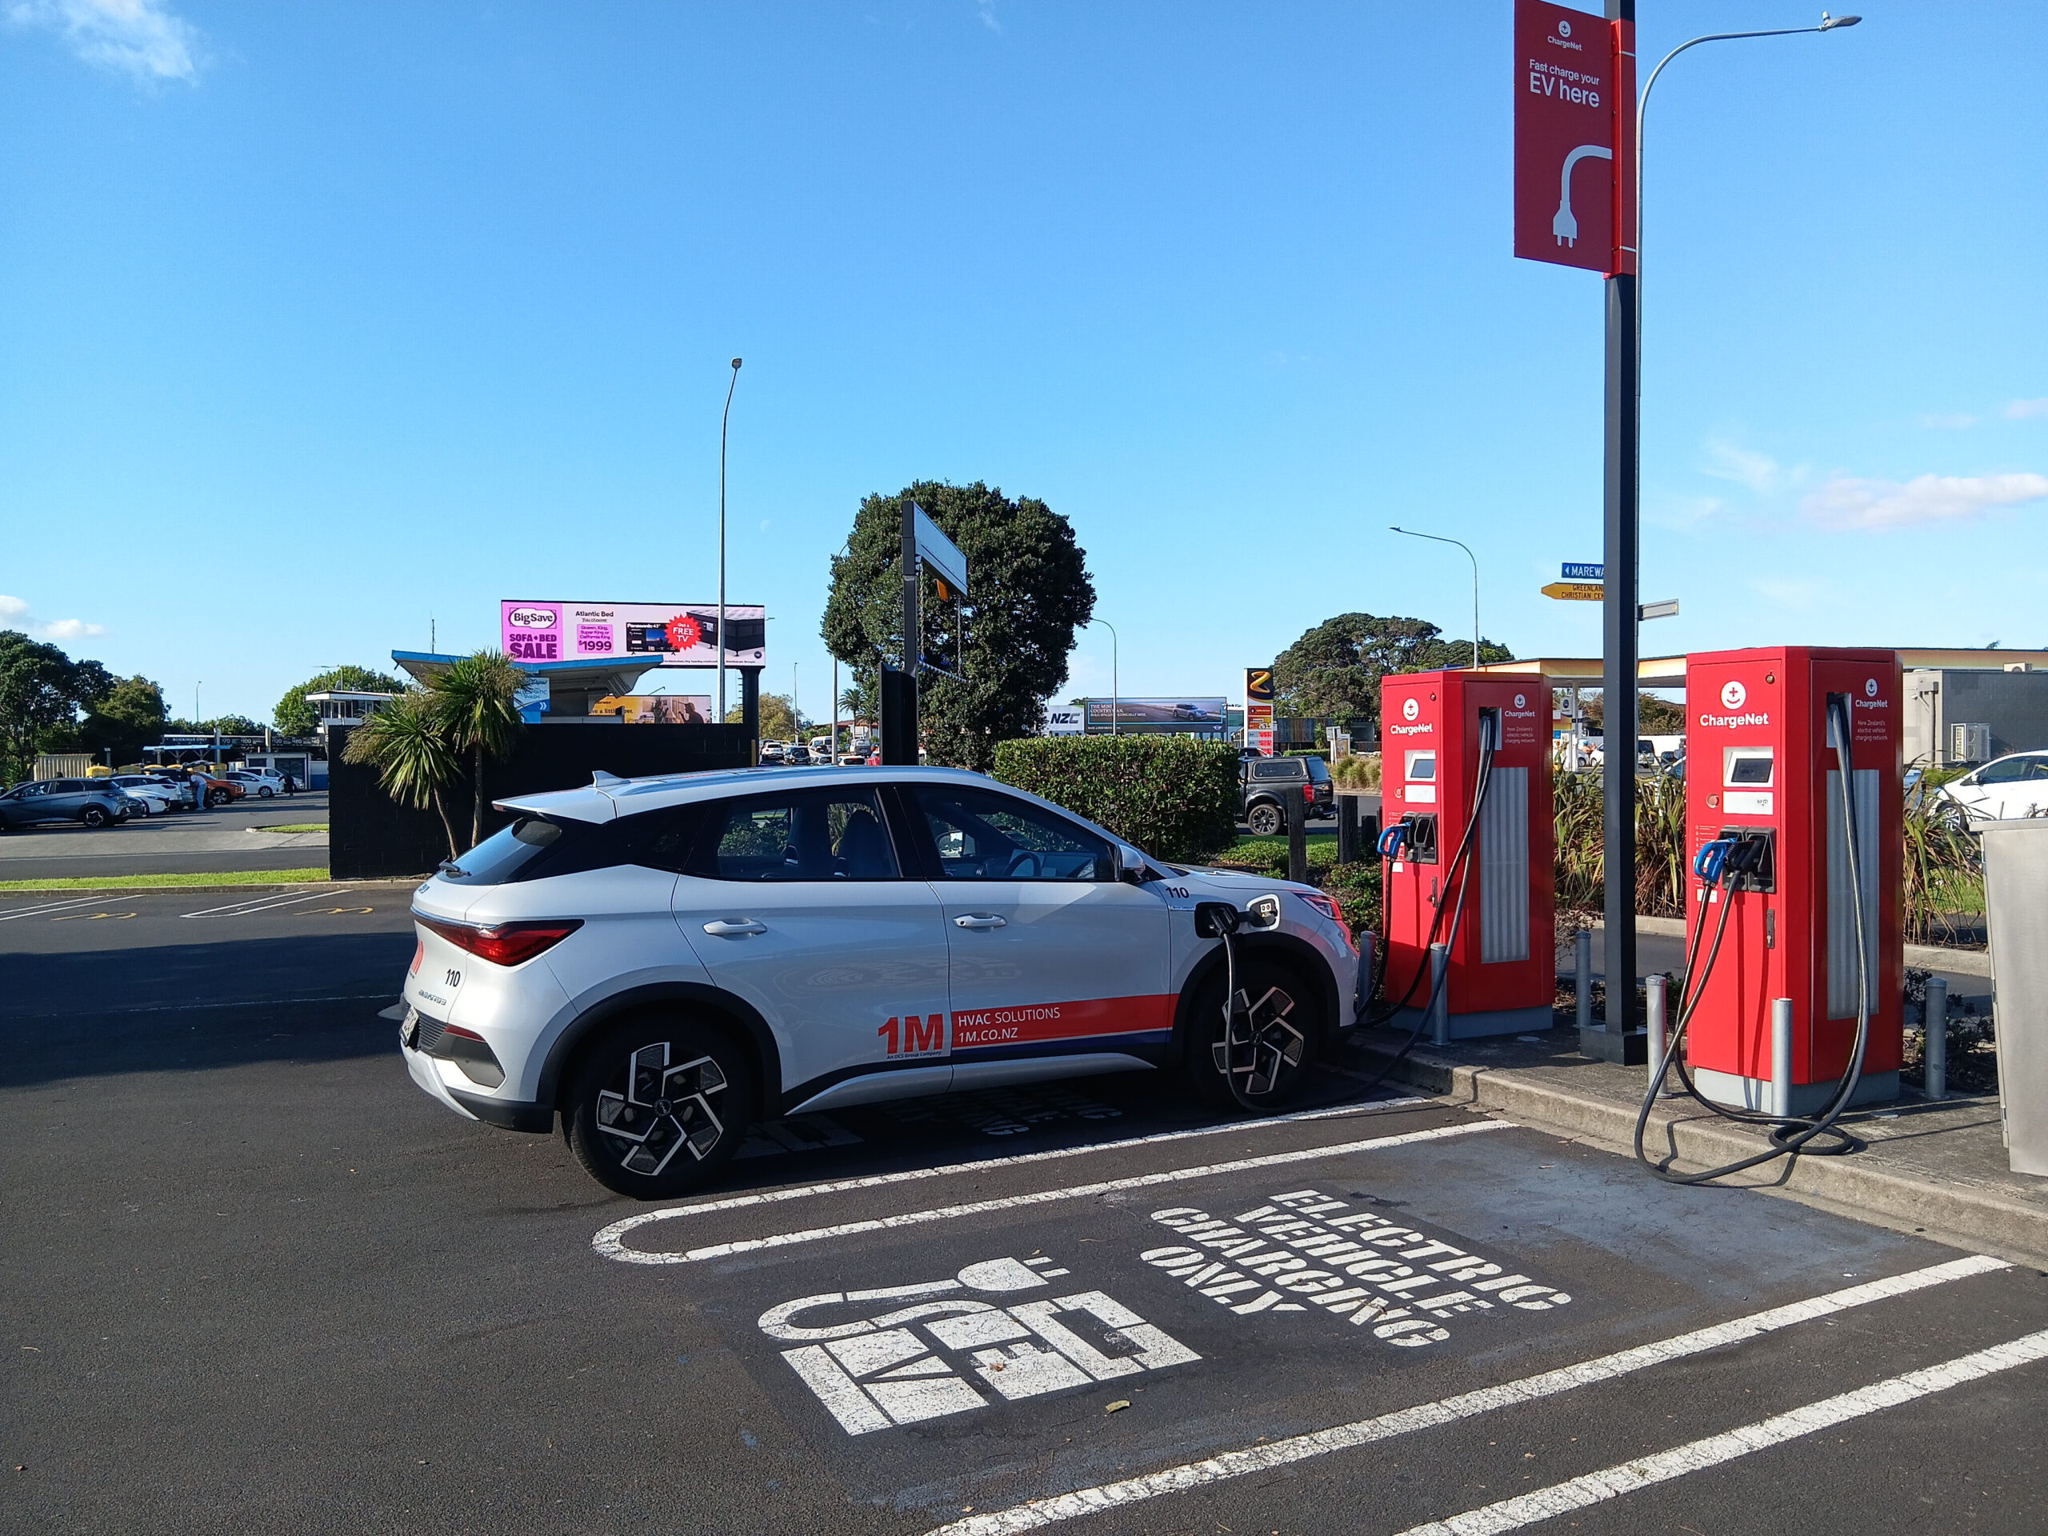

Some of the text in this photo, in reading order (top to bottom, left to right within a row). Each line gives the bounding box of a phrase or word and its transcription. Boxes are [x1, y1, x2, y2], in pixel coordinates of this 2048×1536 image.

[1547, 35, 1583, 51] ChargeNet
[1529, 58, 1600, 85] Fast charge your
[1530, 71, 1600, 107] EV here
[1561, 591, 1591, 599] CHRISTIAN
[509, 634, 557, 642] SOFA BED
[672, 627, 694, 635] FREE
[509, 643, 557, 659] SALE
[1855, 699, 1888, 709] ChargeNet
[1050, 712, 1081, 724] NZC
[1503, 710, 1536, 718] ChargeNet
[1699, 712, 1769, 729] ChargeNet
[1390, 723, 1433, 736] ChargeNet
[1165, 887, 1190, 899] 110
[445, 968, 461, 988] 110
[958, 1007, 1061, 1027] HVAC SOLUTIONS
[878, 1013, 943, 1055] 1M
[959, 1027, 1018, 1043] 1M.CO.NZ
[1269, 1189, 1572, 1310] ELECTRIC
[1234, 1205, 1495, 1319] VEHICLE
[1139, 1246, 1308, 1315] ONLY
[1150, 1207, 1450, 1347] CHARGING
